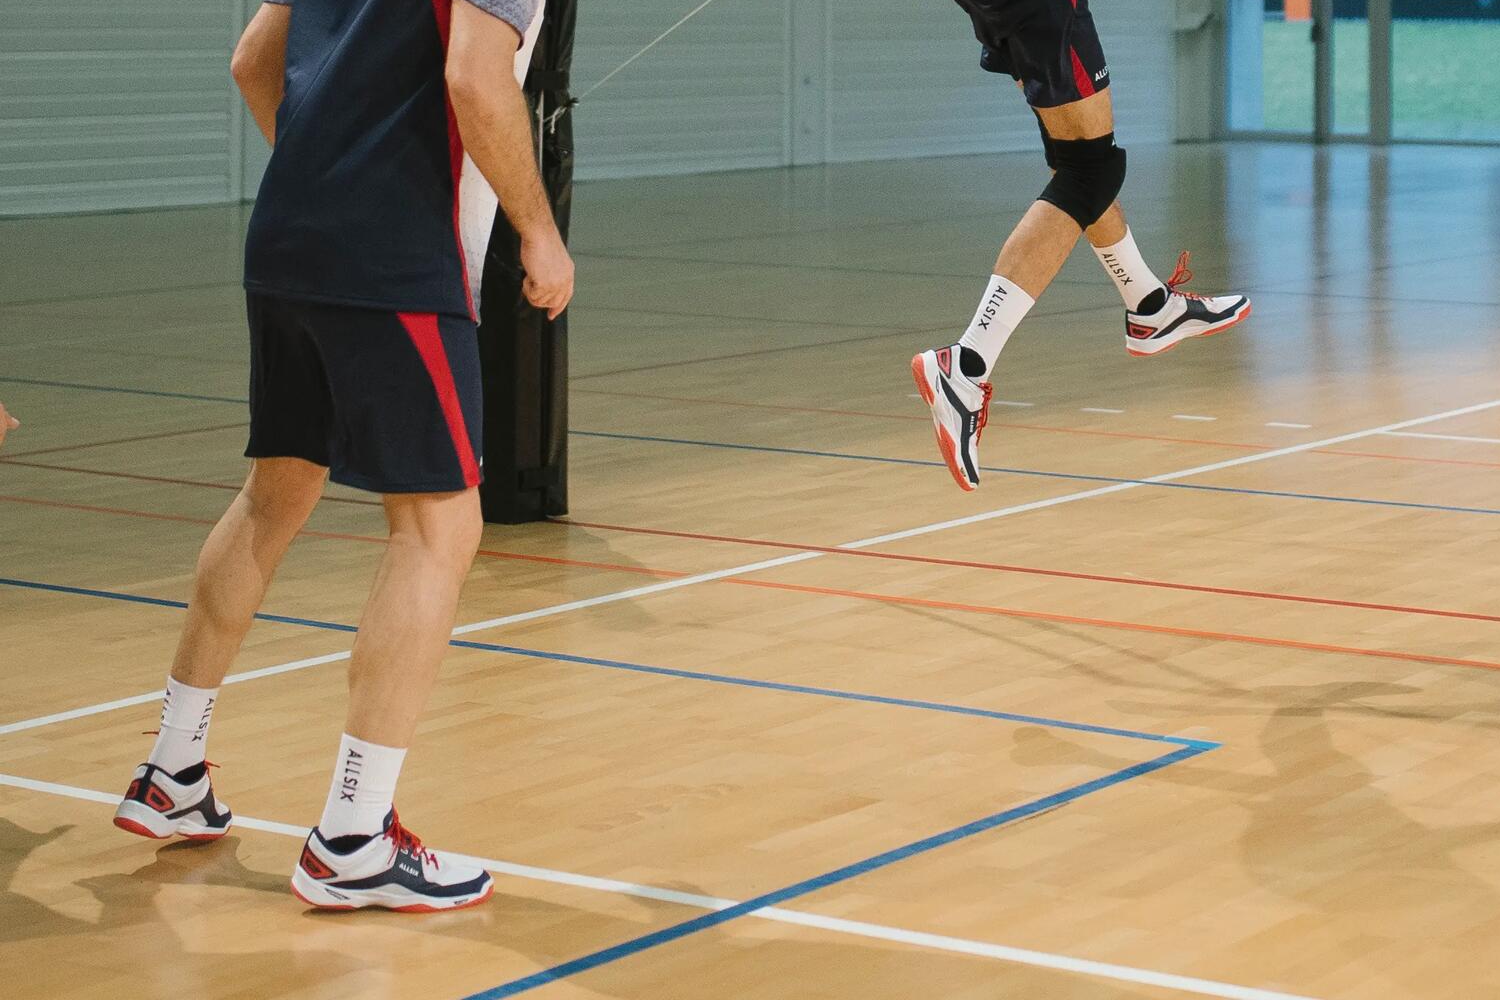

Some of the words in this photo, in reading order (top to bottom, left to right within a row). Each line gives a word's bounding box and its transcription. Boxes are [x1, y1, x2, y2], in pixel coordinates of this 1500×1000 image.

[1095, 65, 1109, 81] ALLS
[1102, 253, 1134, 286] ALLSIX
[977, 285, 1008, 331] ALLSIX
[191, 697, 215, 742] ALLSIX
[340, 748, 363, 803] ALLSIX
